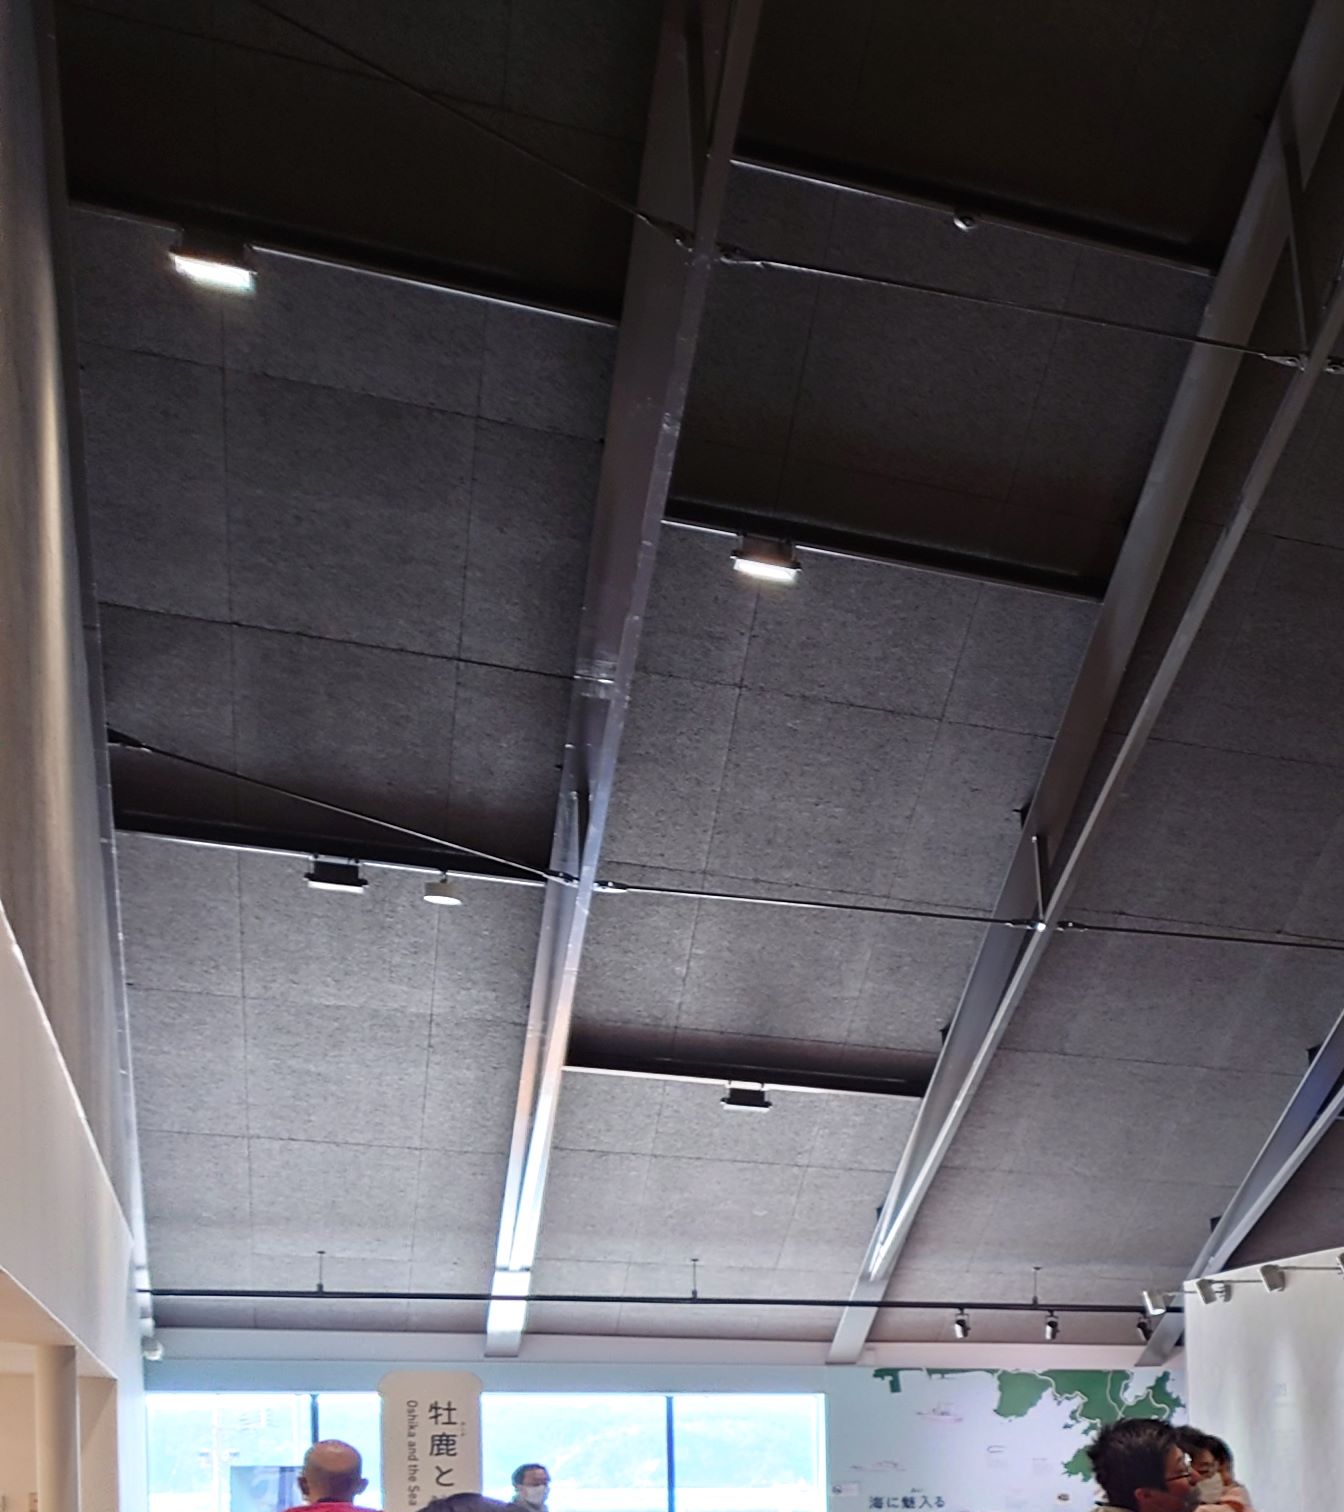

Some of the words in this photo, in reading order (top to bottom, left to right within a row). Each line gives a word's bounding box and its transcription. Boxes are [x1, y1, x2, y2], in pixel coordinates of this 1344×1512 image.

[406, 1399, 419, 1438] Oshika
[407, 1441, 420, 1462] and
[428, 1400, 458, 1500] 牡鹿と
[407, 1464, 420, 1482] the
[407, 1485, 421, 1507] Sea
